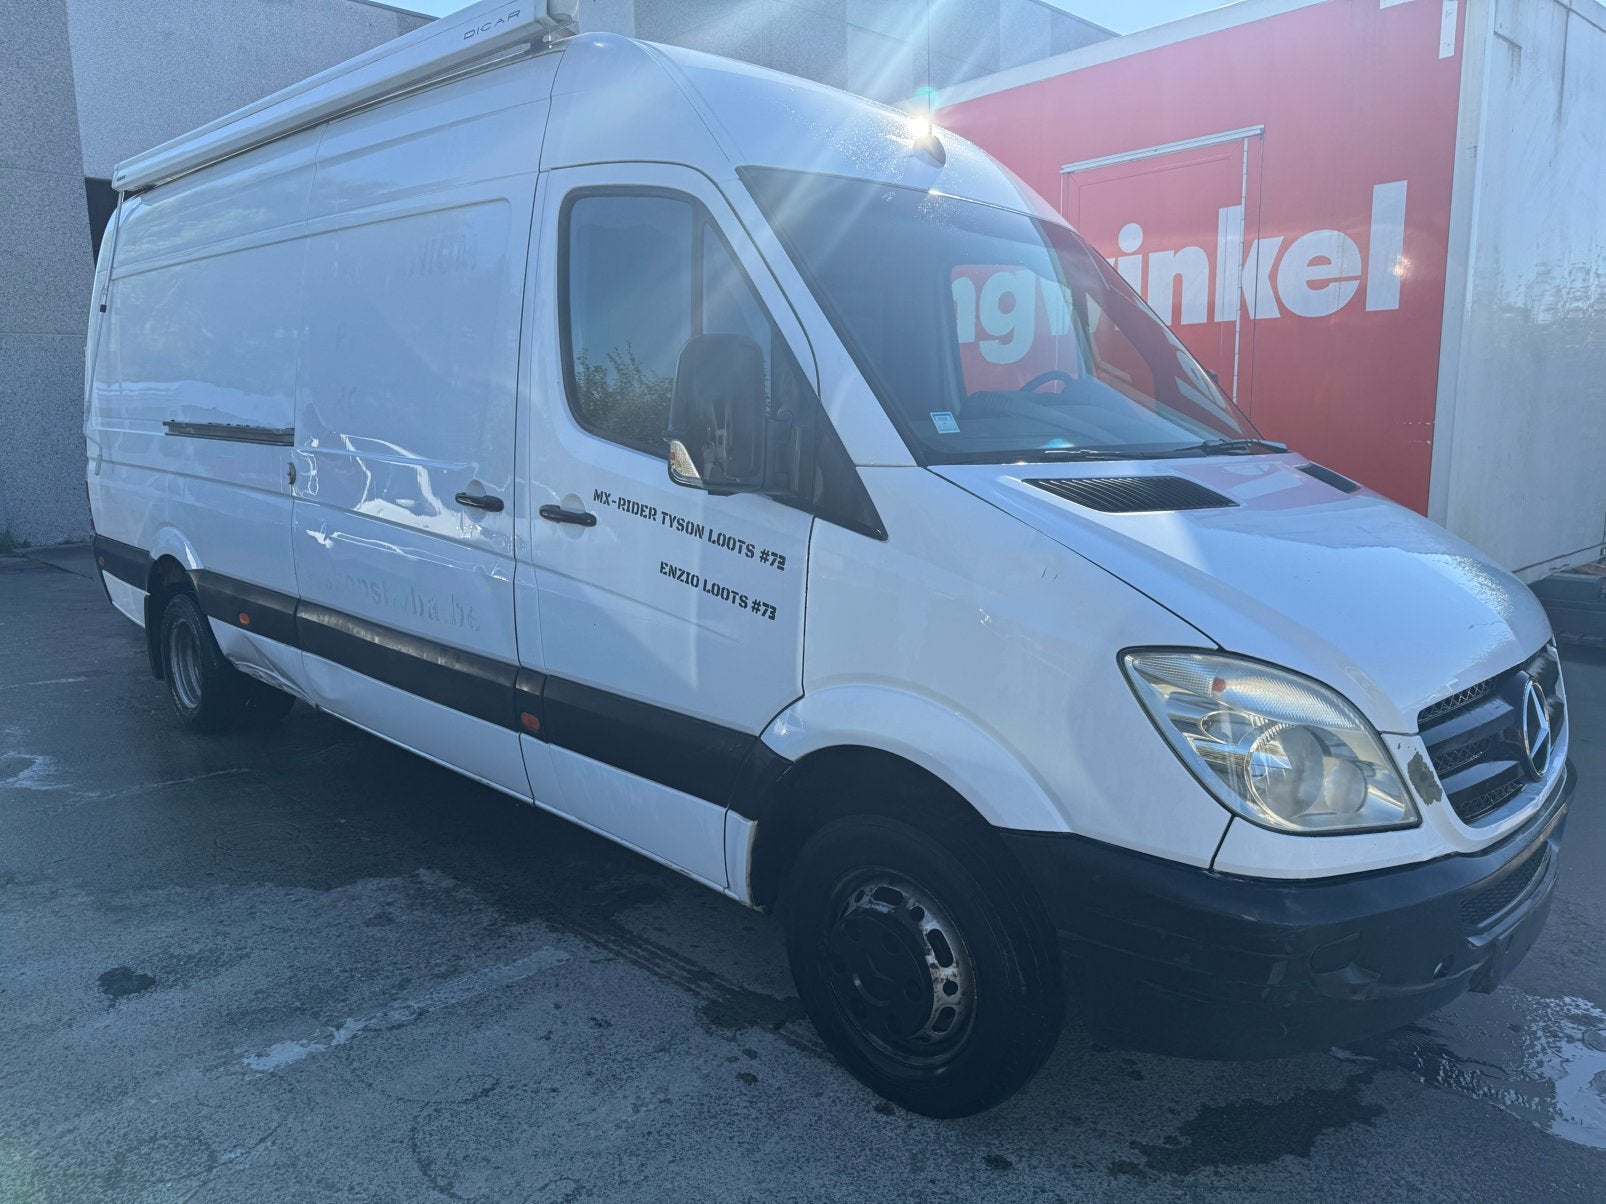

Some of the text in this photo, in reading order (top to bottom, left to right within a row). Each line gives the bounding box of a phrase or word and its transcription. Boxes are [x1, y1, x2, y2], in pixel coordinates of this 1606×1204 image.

[463, 9, 521, 40] DICAR
[593, 488, 787, 572] MX-RIDER TYSON LOOTS #72
[659, 560, 777, 621] ENZIO LOOTS #73
